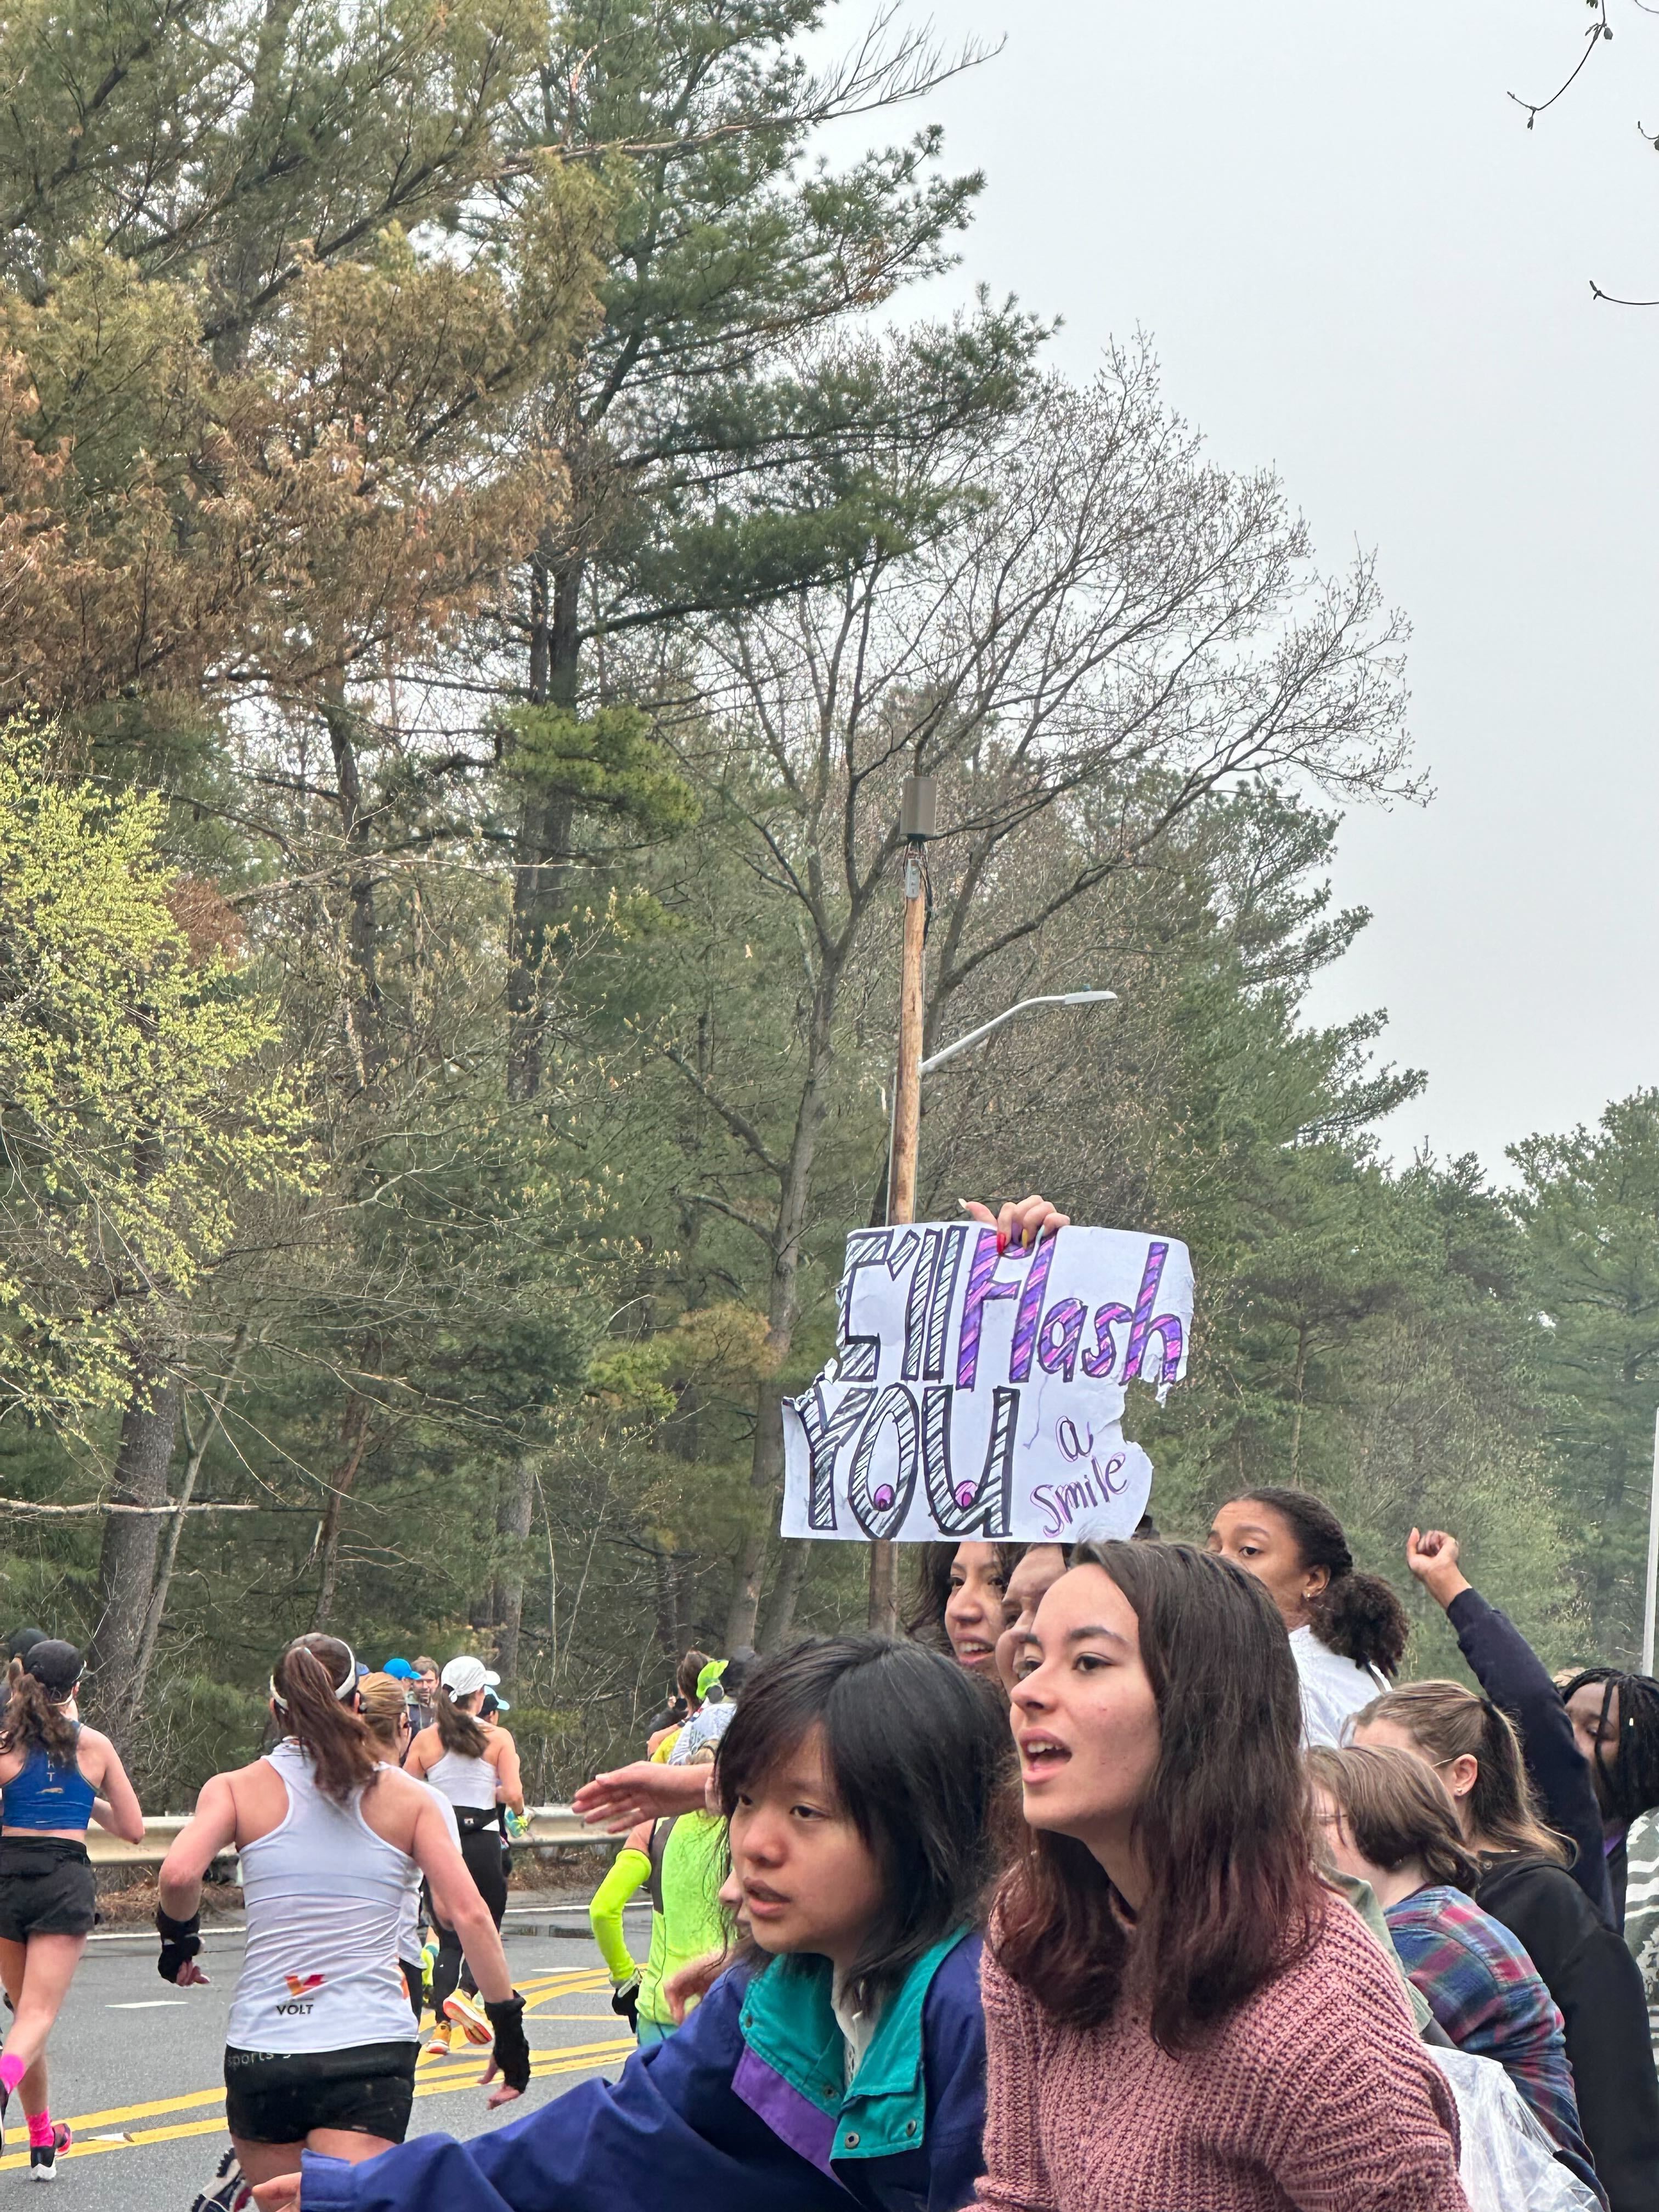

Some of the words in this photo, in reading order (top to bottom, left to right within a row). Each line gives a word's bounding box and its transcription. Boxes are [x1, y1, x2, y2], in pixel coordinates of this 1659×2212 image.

[955, 1227, 1183, 1392] Flash
[1055, 1415, 1094, 1463] a
[1030, 1452, 1130, 1538] smile
[276, 2004, 314, 2015] VOLT
